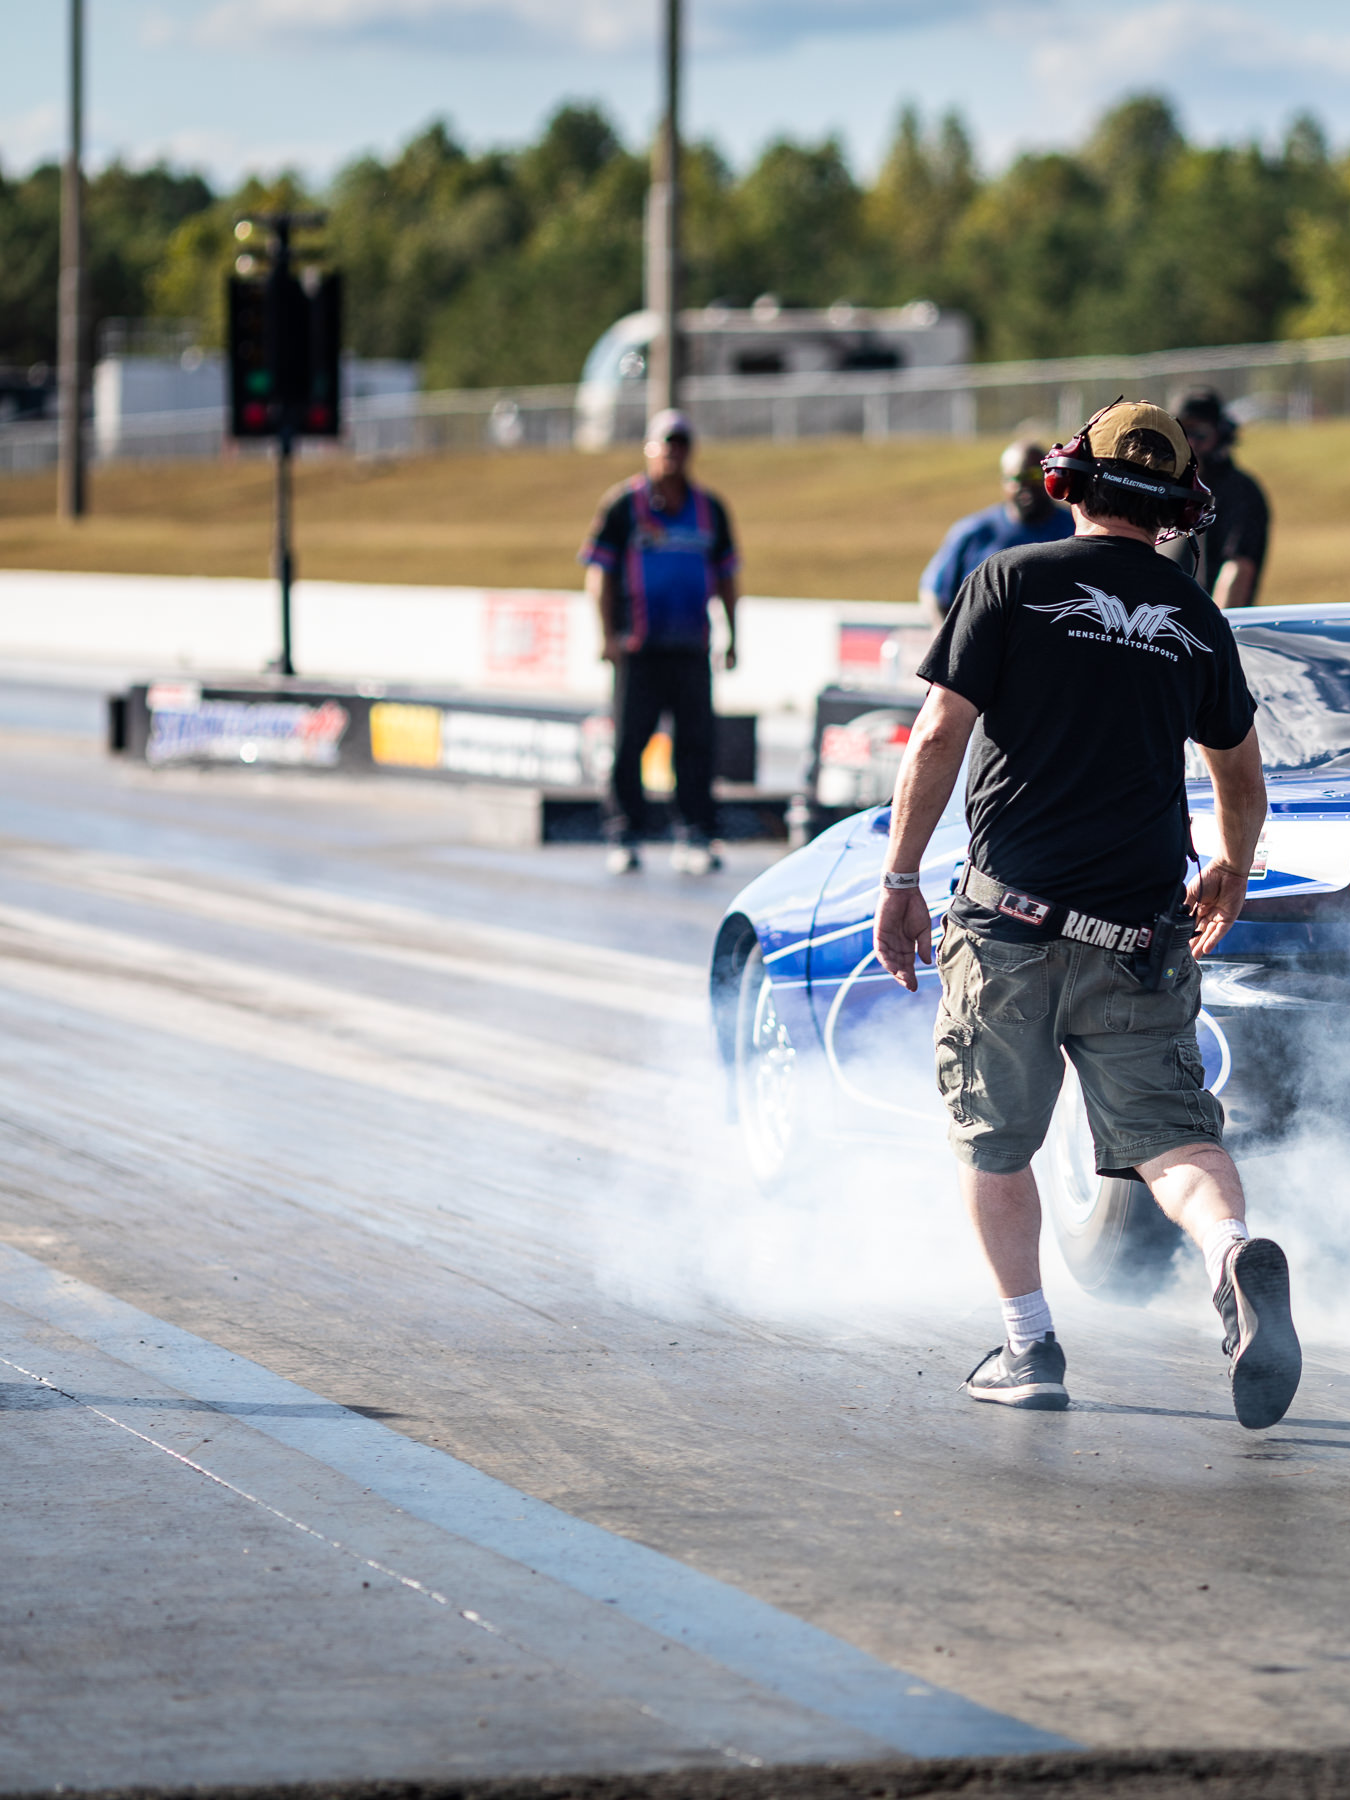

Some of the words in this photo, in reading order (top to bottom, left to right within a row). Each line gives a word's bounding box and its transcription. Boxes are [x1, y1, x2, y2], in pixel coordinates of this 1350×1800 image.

[1068, 629, 1112, 643] MENSCER
[1116, 636, 1179, 662] MOTORSPORTS
[1061, 910, 1122, 949] RACING
